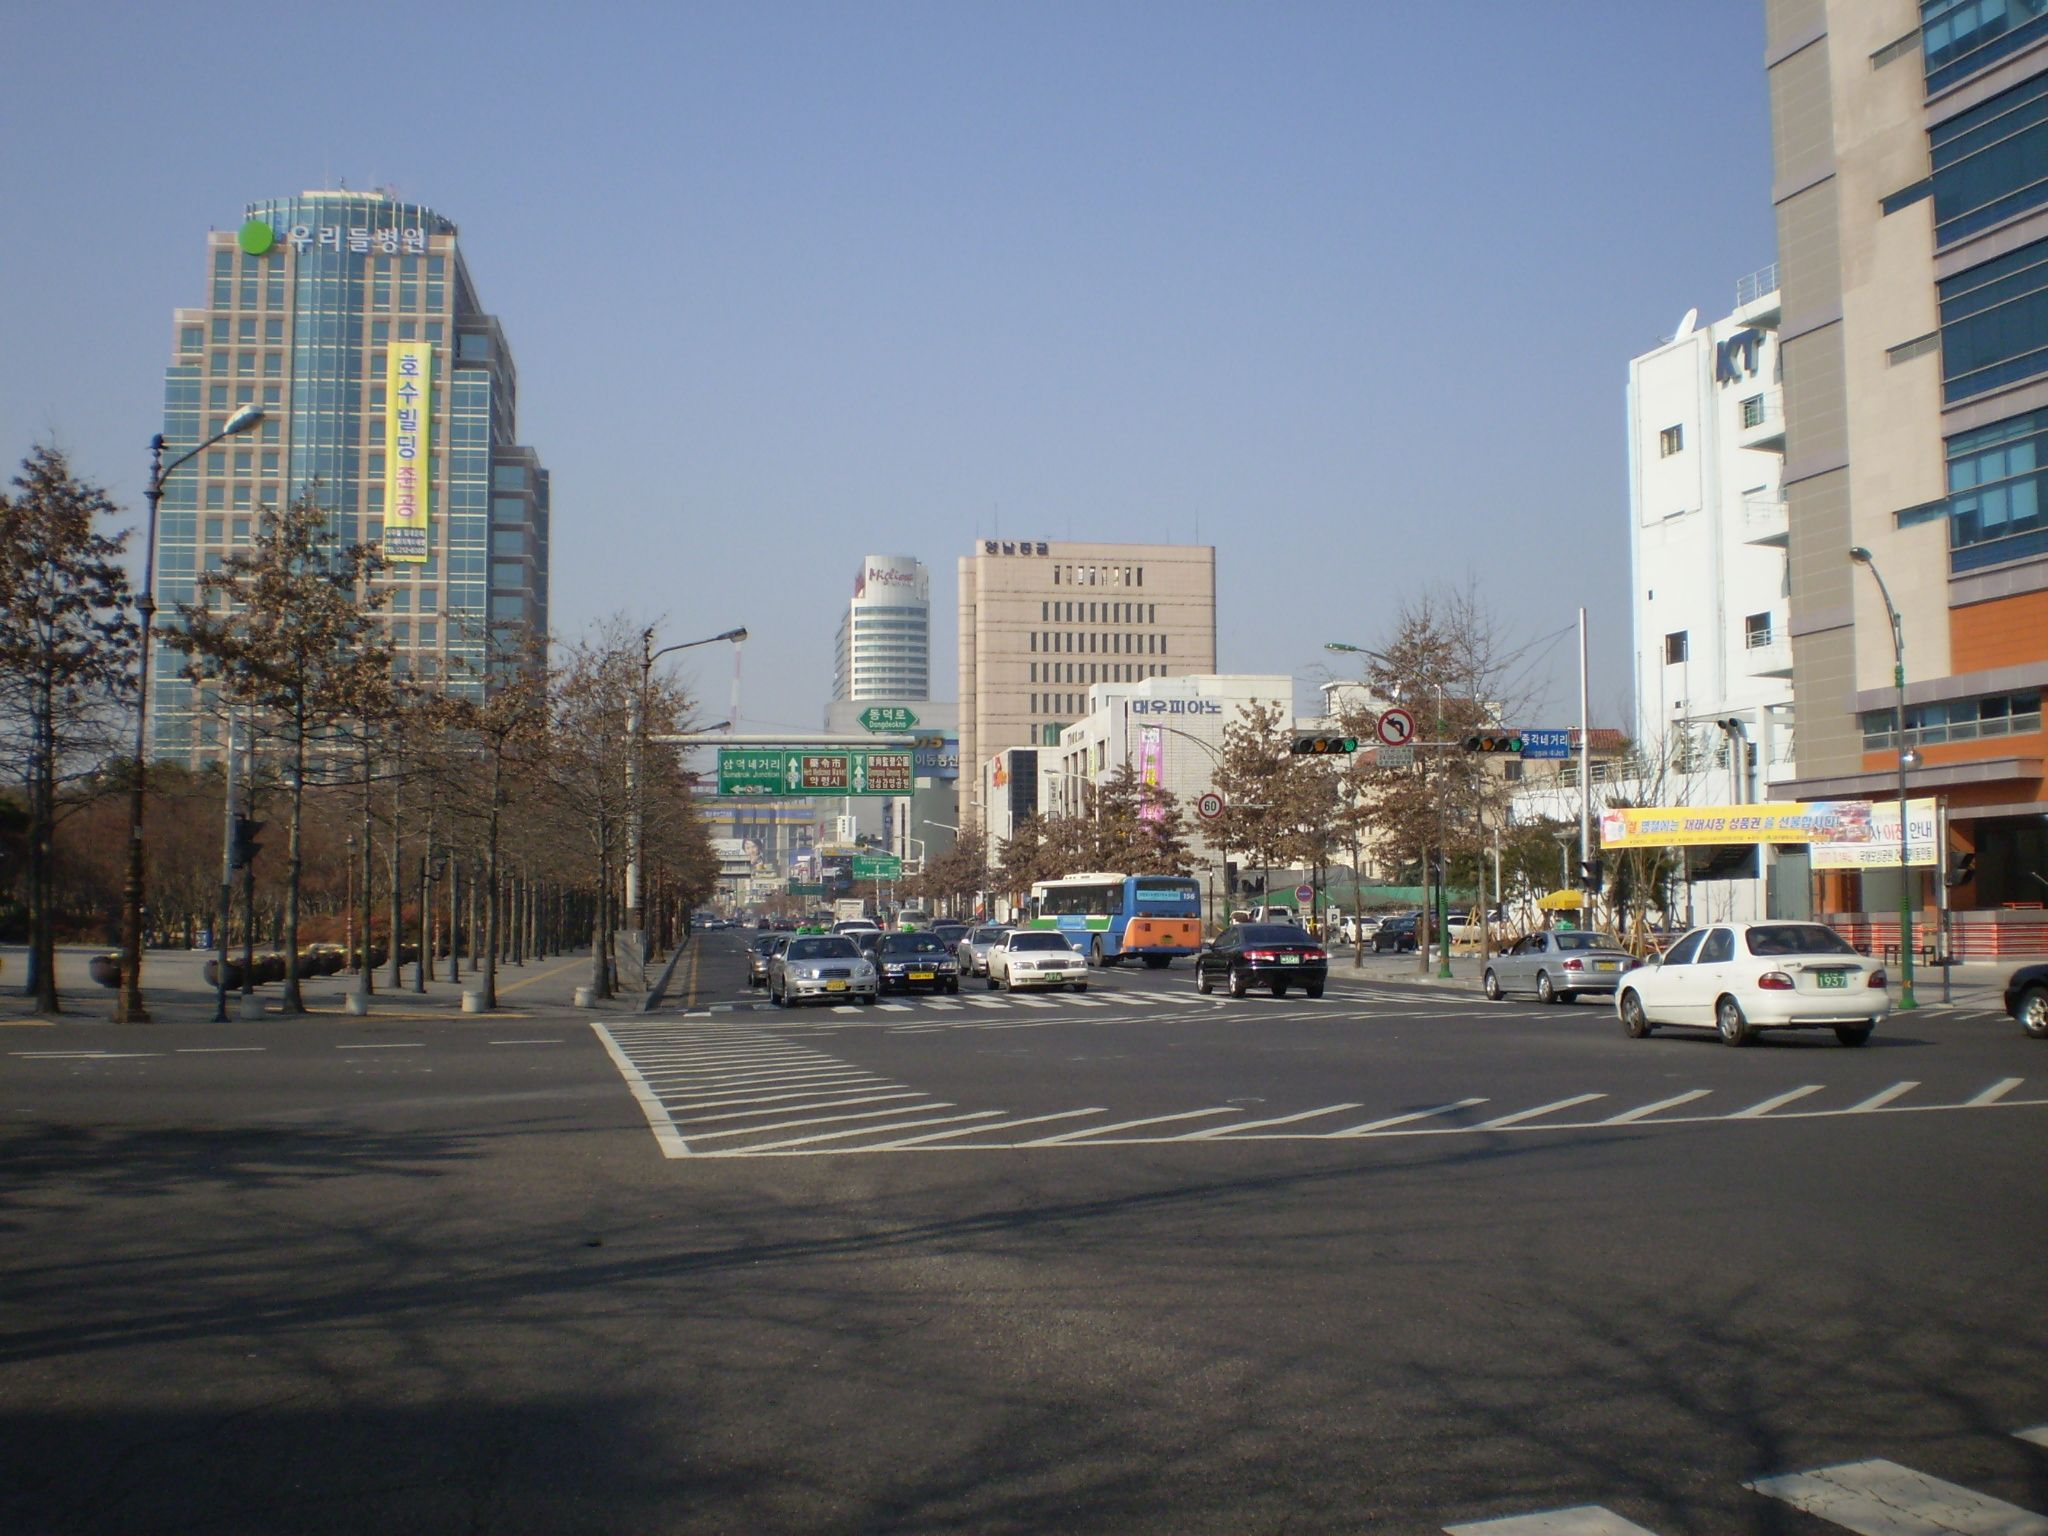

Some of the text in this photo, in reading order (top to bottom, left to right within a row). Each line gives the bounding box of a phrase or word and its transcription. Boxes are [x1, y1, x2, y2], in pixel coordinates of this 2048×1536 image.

[286, 225, 424, 253] 우리들병원
[1716, 328, 1766, 390] KT
[397, 354, 419, 459] 호수빌딩
[396, 466, 416, 517] 준공
[869, 708, 906, 720] 동덕로
[1132, 700, 1222, 714] 대우피아노
[723, 759, 780, 770] 삼덕네거리
[915, 753, 959, 767] 이동통신
[1204, 801, 1217, 811] 60
[1684, 818, 1725, 831] 재래시장
[1729, 816, 1761, 830] 상품권
[1909, 820, 1933, 840] 안내
[1183, 892, 1196, 900] 156
[1331, 913, 1338, 922] P
[1820, 976, 1845, 987] 1937
